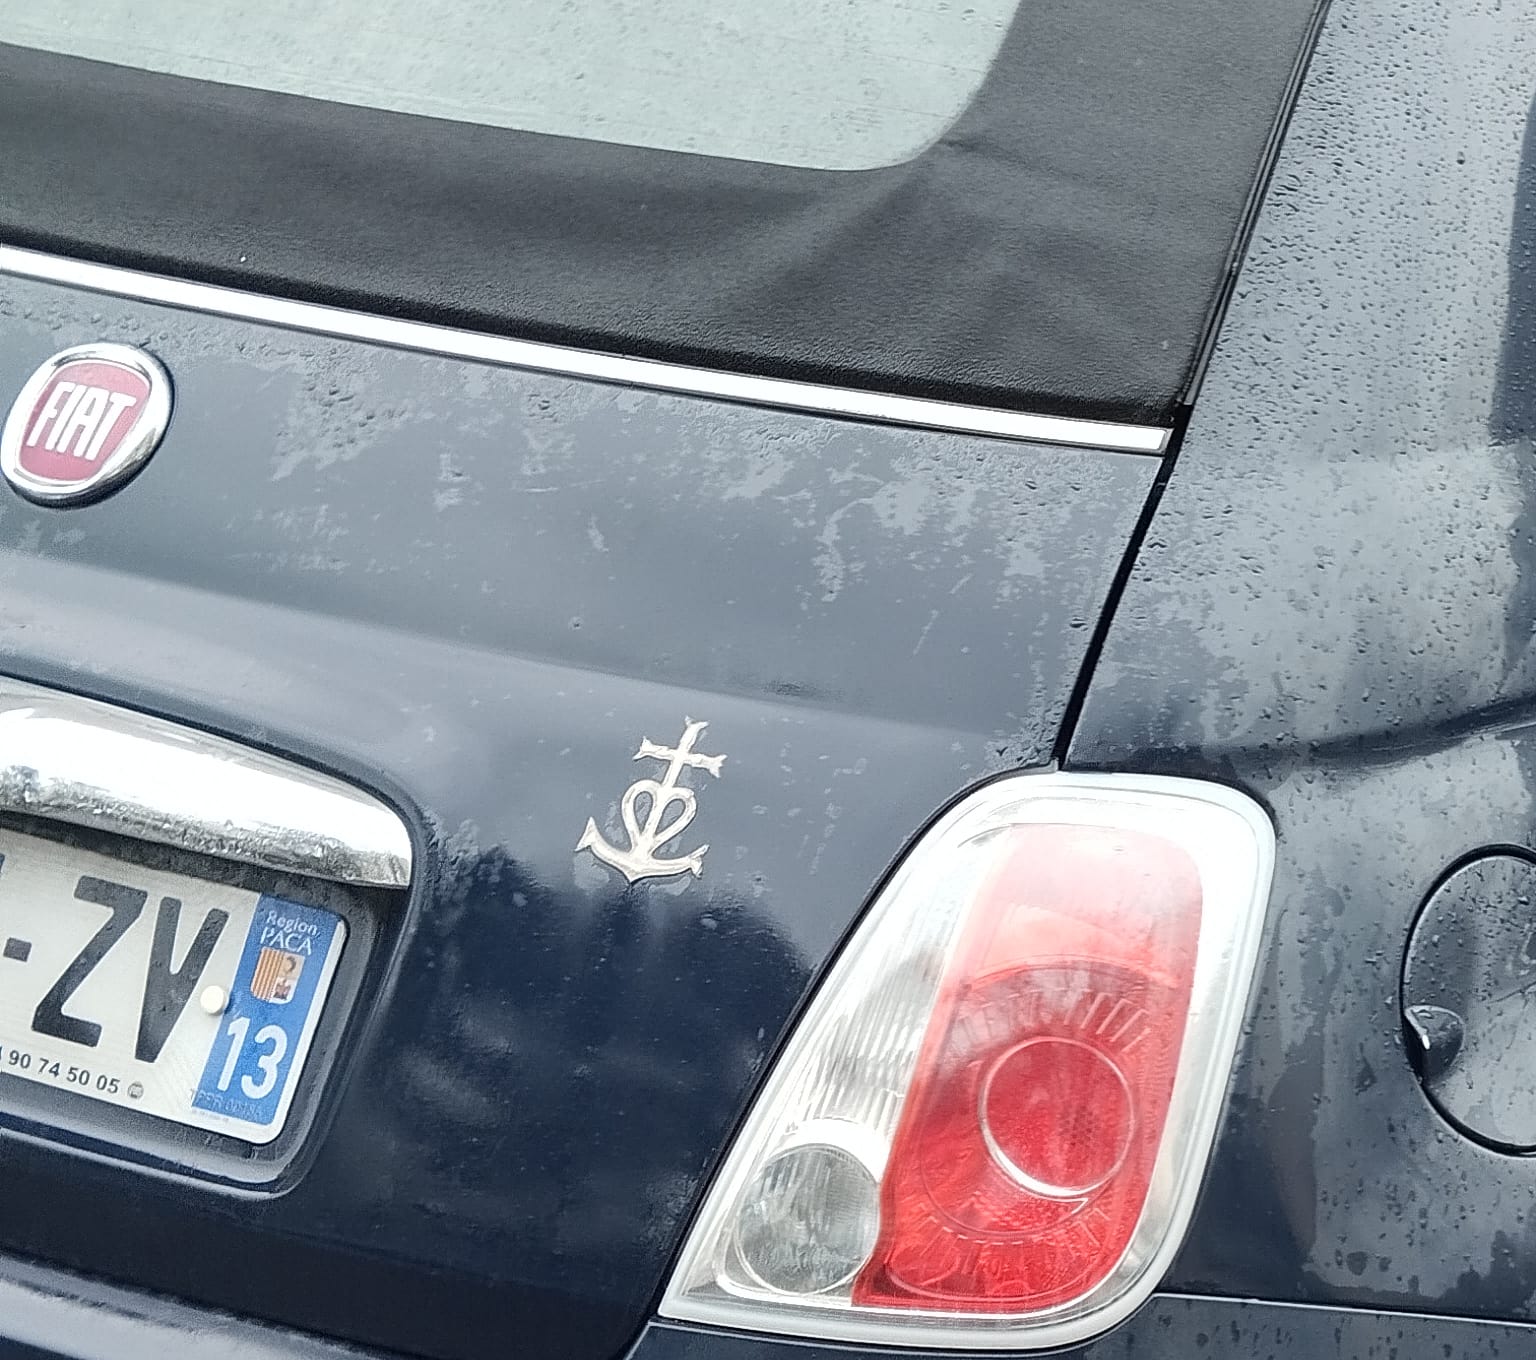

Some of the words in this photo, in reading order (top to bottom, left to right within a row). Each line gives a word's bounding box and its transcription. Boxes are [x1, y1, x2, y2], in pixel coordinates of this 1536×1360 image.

[26, 381, 137, 461] FIAT
[0, 853, 230, 1064] -ZV
[260, 926, 312, 956] PACA
[8, 1049, 32, 1070] 90
[37, 1057, 61, 1079] 74
[66, 1066, 91, 1087] 50
[96, 1074, 121, 1095] 05
[216, 1015, 288, 1100] 13
